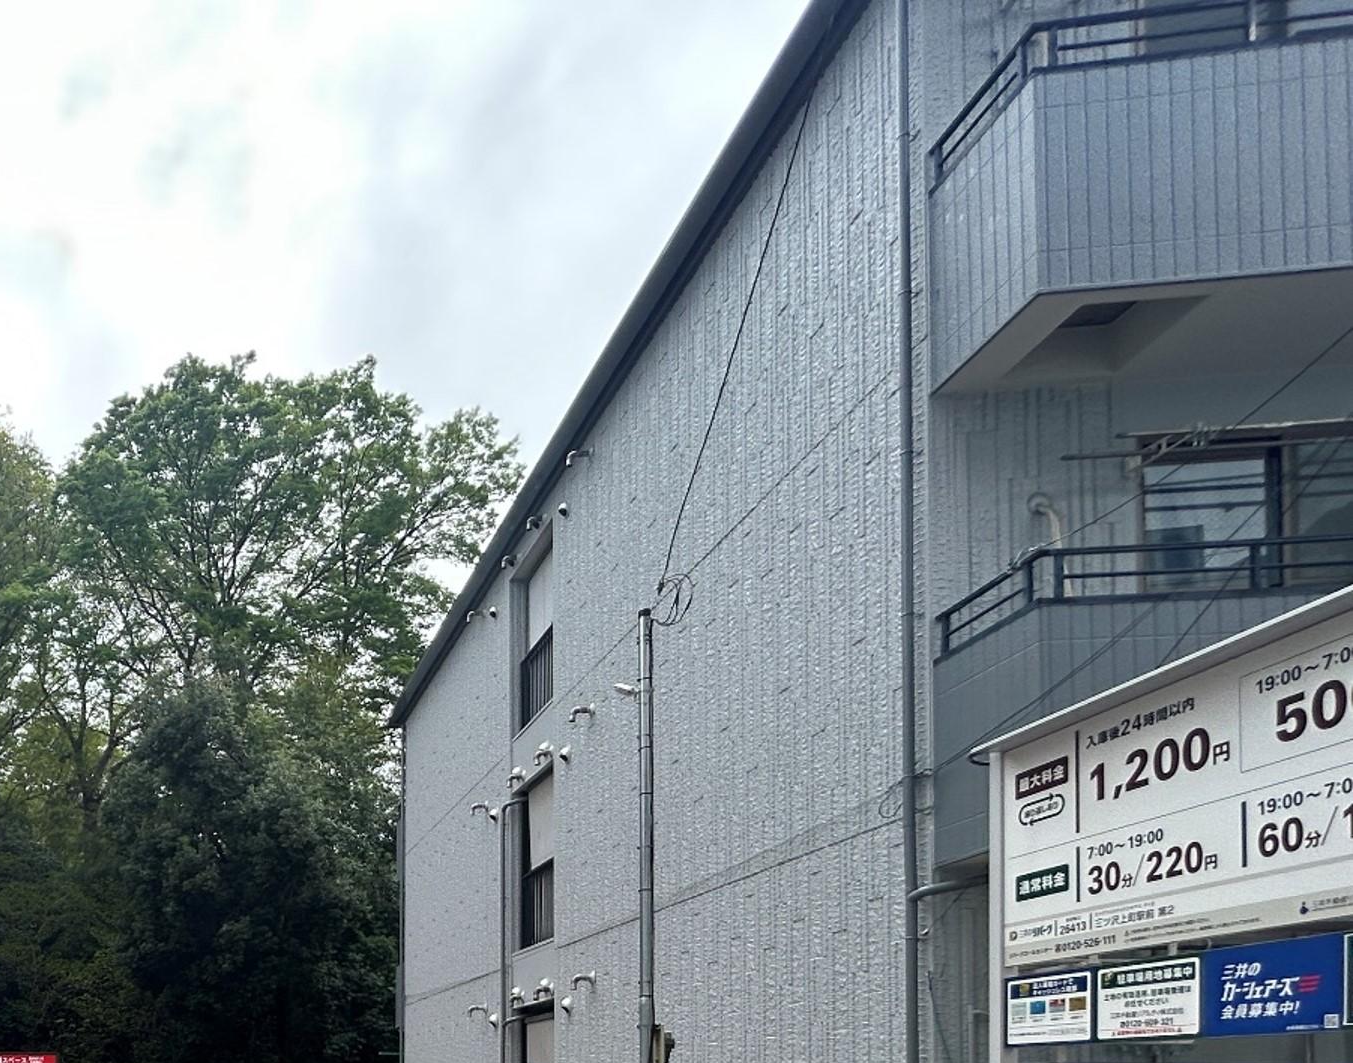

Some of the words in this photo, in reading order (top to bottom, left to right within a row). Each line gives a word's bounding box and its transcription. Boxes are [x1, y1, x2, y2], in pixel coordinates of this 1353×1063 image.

[1255, 646, 1353, 694] 19:00～7:0
[1276, 679, 1353, 742] 50
[1089, 727, 1231, 800] 1,200円
[1018, 871, 1067, 895] 通常料金
[1220, 962, 1262, 980] 三井の
[1220, 976, 1301, 1001] カーシェアーズ
[1220, 1000, 1301, 1020] 会員募集中!
